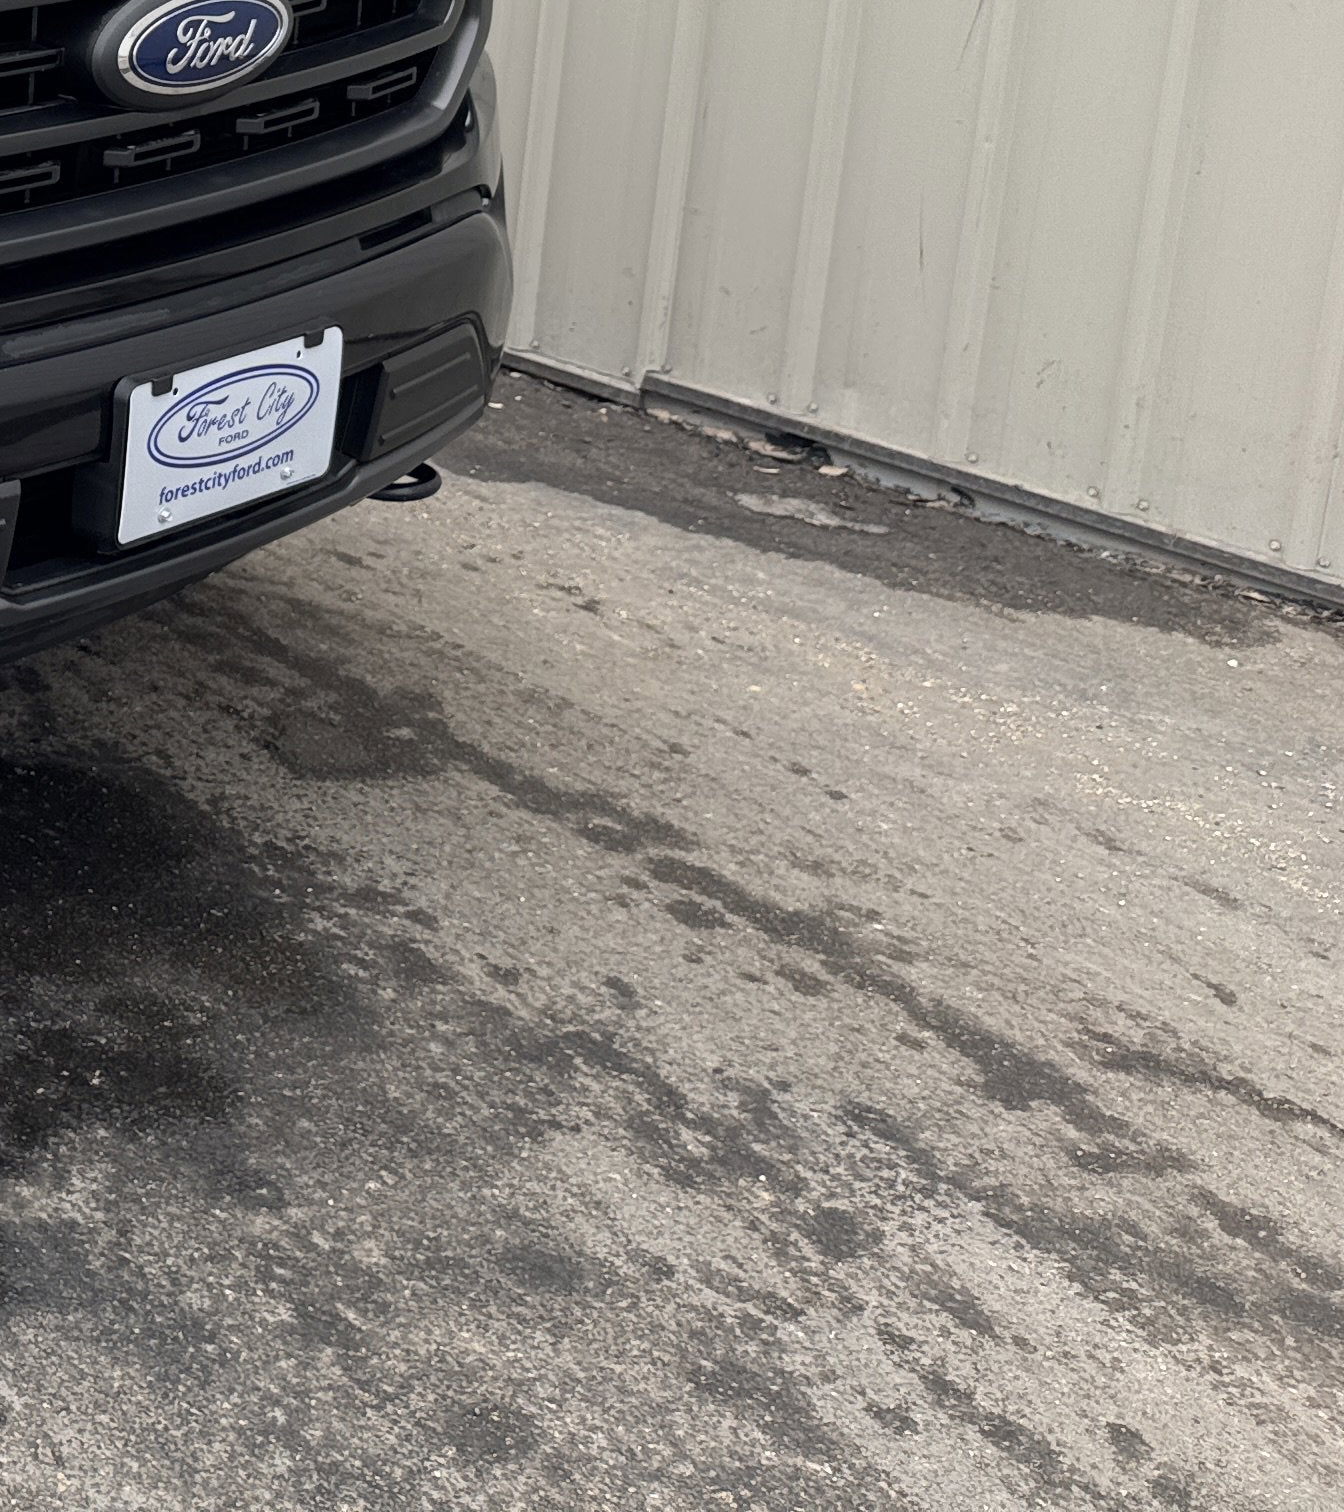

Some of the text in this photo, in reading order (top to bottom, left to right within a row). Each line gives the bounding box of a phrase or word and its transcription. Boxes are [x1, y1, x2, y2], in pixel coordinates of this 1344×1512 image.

[166, 10, 257, 74] Ford
[177, 381, 296, 444] Forest City
[217, 428, 250, 447] FORD
[158, 448, 295, 506] forestcityford.com
